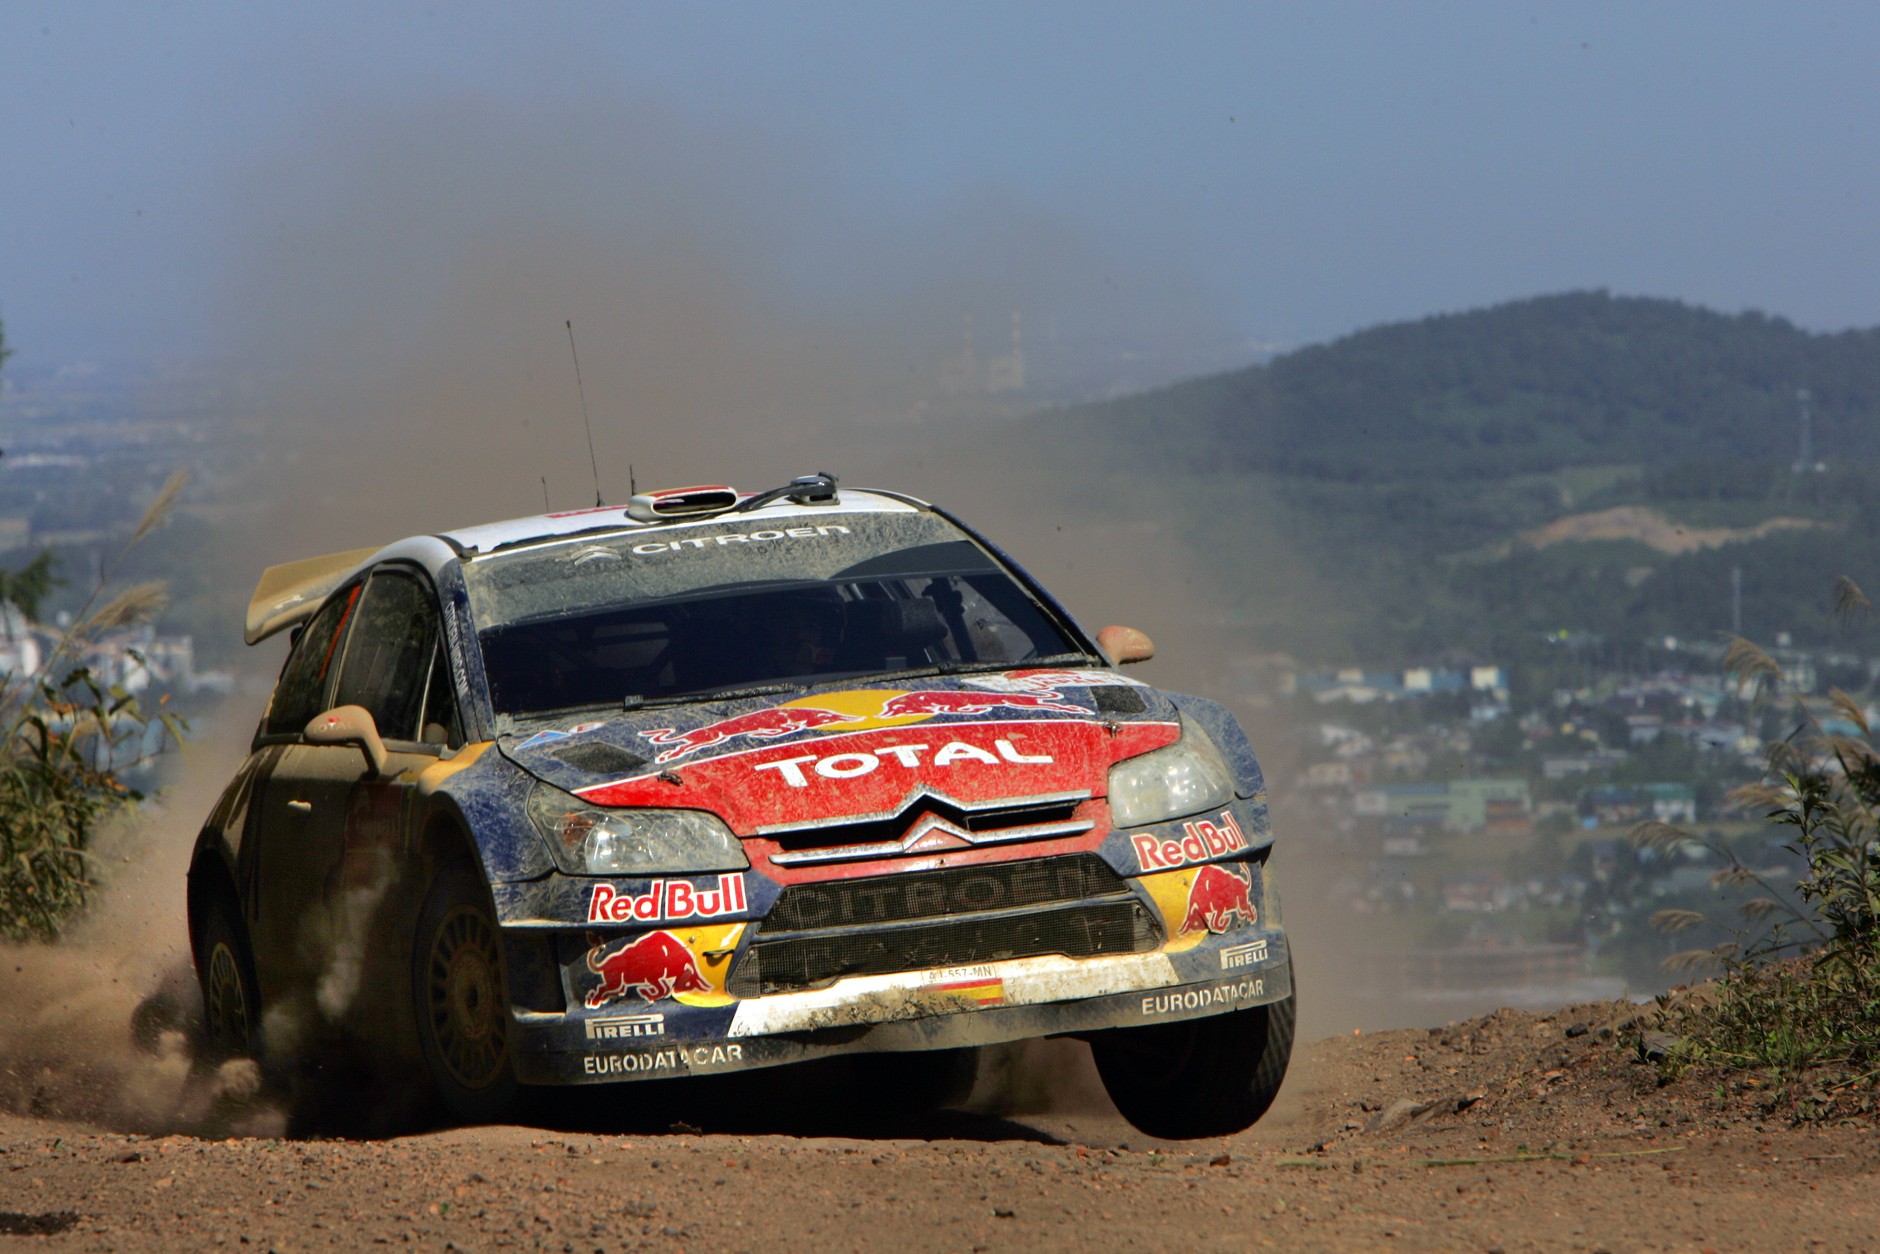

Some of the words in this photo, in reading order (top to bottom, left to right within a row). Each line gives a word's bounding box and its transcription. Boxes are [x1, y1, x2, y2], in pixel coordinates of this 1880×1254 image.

[754, 740, 1054, 788] TOTAL
[1131, 821, 1208, 872] Red
[1198, 810, 1250, 858] Bull
[588, 880, 664, 922] Red
[665, 872, 748, 920] Bull
[1220, 940, 1268, 969] PIRELLI
[1142, 979, 1264, 1015] EURODATACAR
[585, 1014, 665, 1039] PIRELLI
